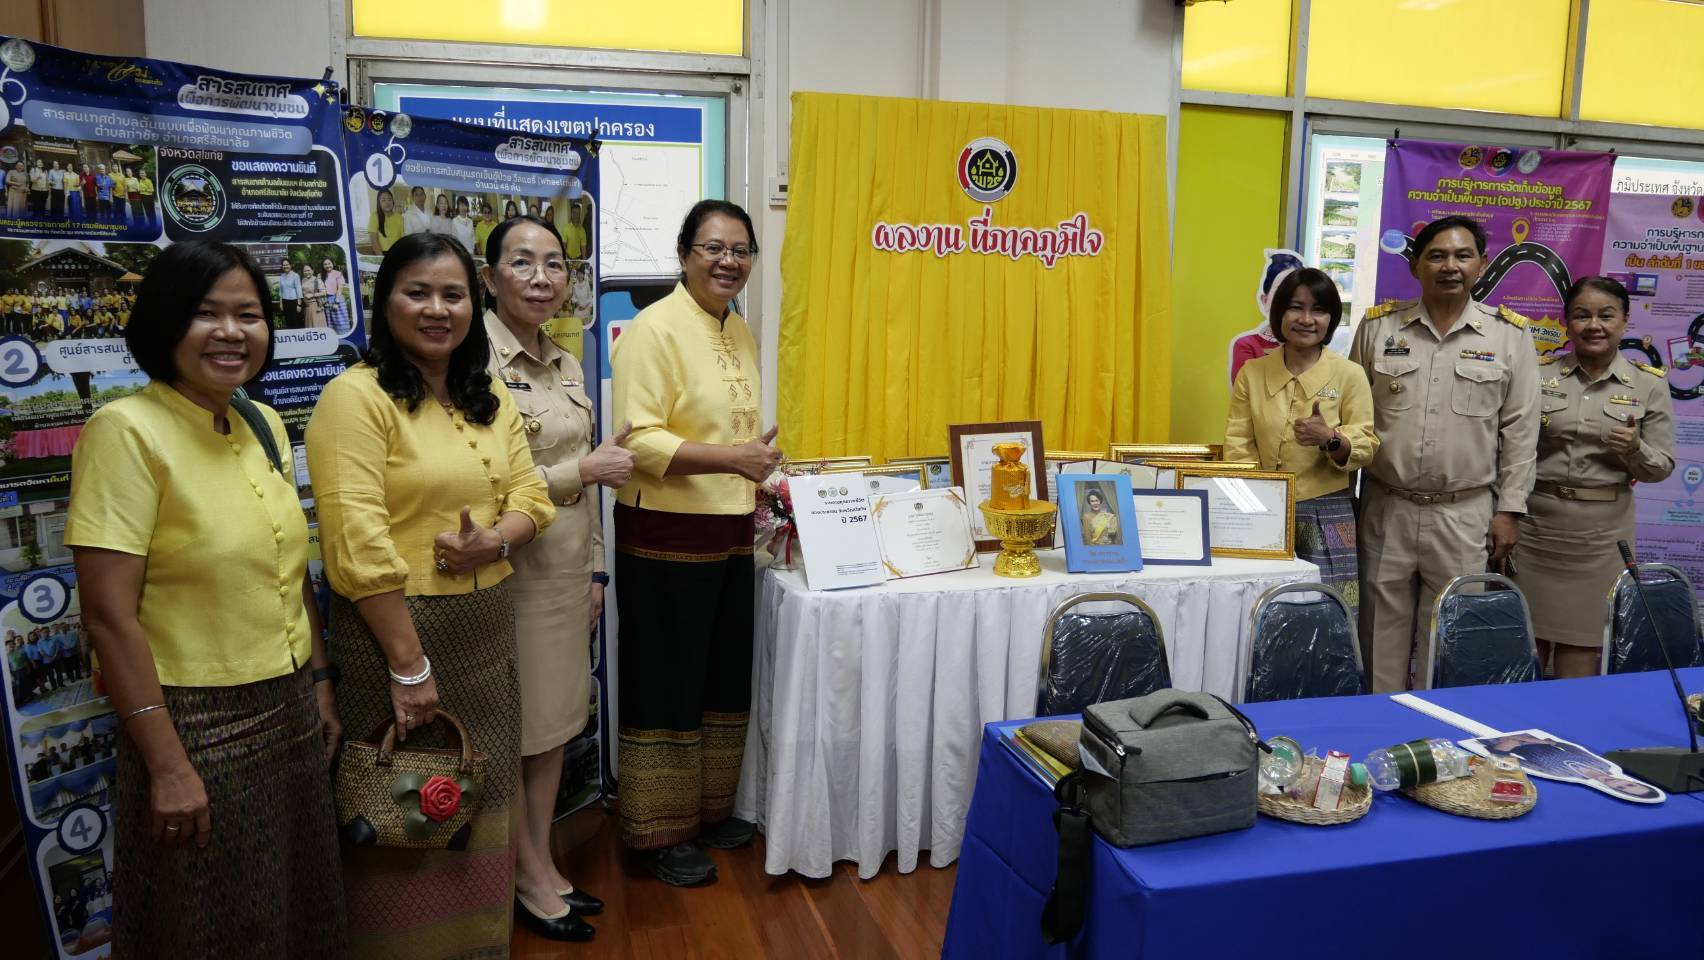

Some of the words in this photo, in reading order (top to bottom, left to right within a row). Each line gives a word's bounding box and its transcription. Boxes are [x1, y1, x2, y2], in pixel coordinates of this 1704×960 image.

[198, 76, 290, 99] สารสนเทศ
[508, 134, 570, 155] สารสนเทศ
[371, 156, 383, 181] 1
[1437, 177, 1563, 199] การบริหารการจัดเก็บข้อมูล
[1564, 200, 1592, 211] 2567
[873, 222, 963, 257] ผลงาน
[968, 206, 1103, 268] ที่ภาคภูมิใจ
[3, 348, 31, 375] 2
[848, 514, 867, 523] 2567
[33, 585, 55, 613] 3
[69, 814, 93, 844] 4
